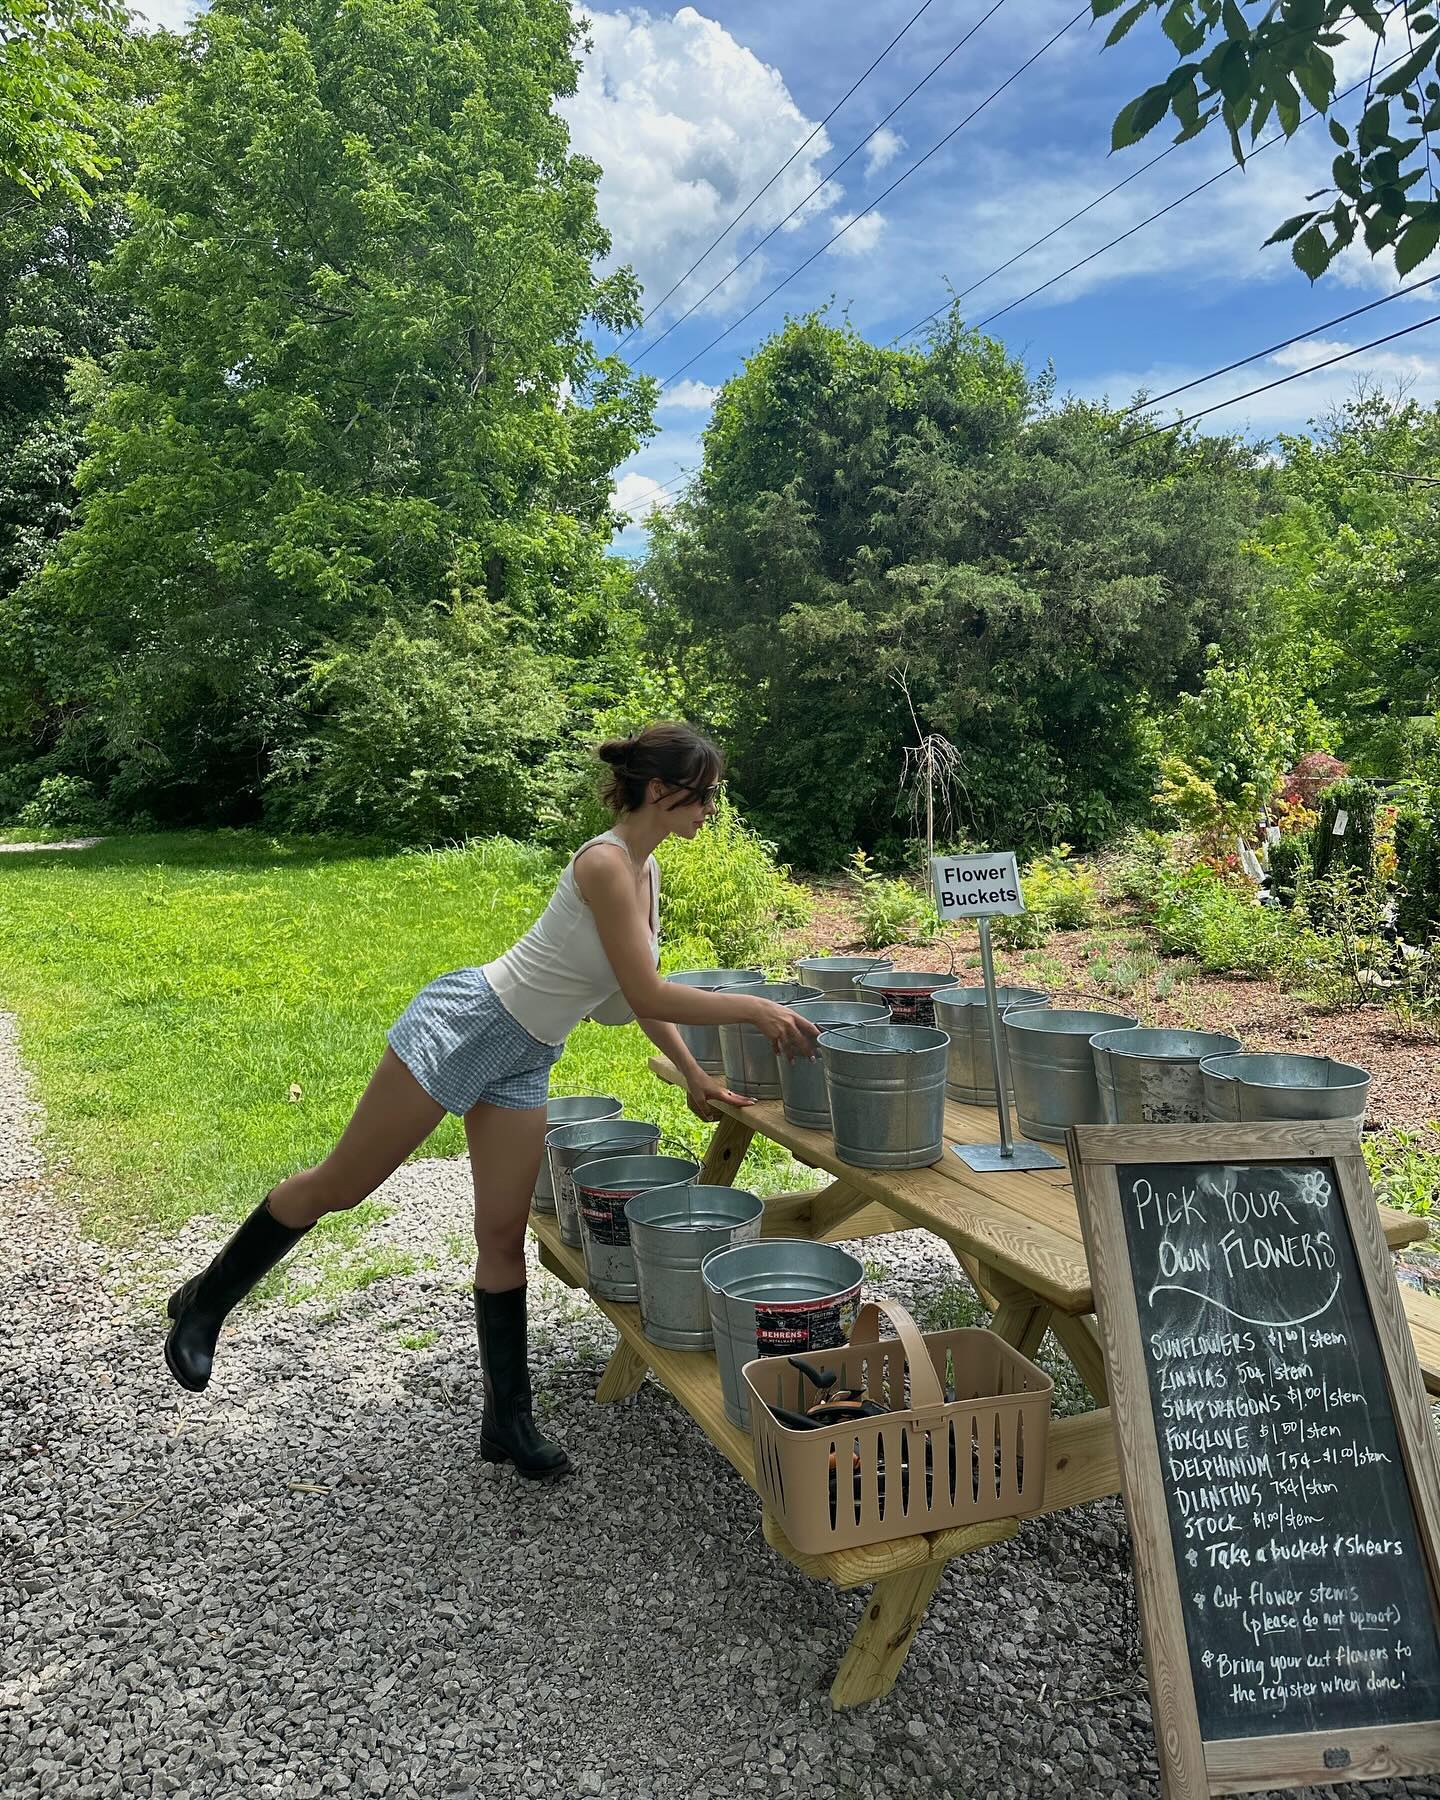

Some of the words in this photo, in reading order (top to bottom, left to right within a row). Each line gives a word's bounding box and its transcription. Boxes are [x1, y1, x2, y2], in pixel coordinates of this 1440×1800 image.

[944, 866, 1007, 884] Flower
[941, 887, 1017, 908] Buckets
[1133, 1179, 1207, 1229] PICK
[1210, 1180, 1299, 1225] YOUR
[1159, 1241, 1210, 1277] OWN
[1218, 1228, 1336, 1278] FLOWERS
[762, 1330, 802, 1339] BEHRENS
[1151, 1332, 1256, 1360] SUNFLOWERS
[1157, 1365, 1226, 1391] ZINNIAS
[1161, 1393, 1281, 1423] SNAPDRAGONS
[1165, 1426, 1248, 1453] FOXGLOVE
[1169, 1453, 1273, 1481] DELPHINIUM
[1173, 1480, 1262, 1517] DIANTHUS
[1184, 1513, 1243, 1540] STOCK
[1205, 1542, 1251, 1569] Take
[1256, 1548, 1268, 1562] a
[1270, 1535, 1328, 1560] bucket
[1213, 1584, 1242, 1609] Cut
[1249, 1581, 1303, 1606] flower
[1309, 1581, 1359, 1603] stems
[1243, 1610, 1297, 1646] (please
[1303, 1608, 1318, 1628] do
[1323, 1609, 1345, 1626] not
[1350, 1604, 1401, 1631] uproot)
[1216, 1653, 1265, 1686] Bring
[1270, 1655, 1302, 1684] your
[1307, 1650, 1331, 1668] cut
[1335, 1645, 1388, 1667] flowers
[1395, 1640, 1412, 1660] to
[1229, 1684, 1256, 1704] the
[1263, 1680, 1317, 1712] register
[1321, 1675, 1361, 1694] when
[1366, 1670, 1406, 1690] done!
